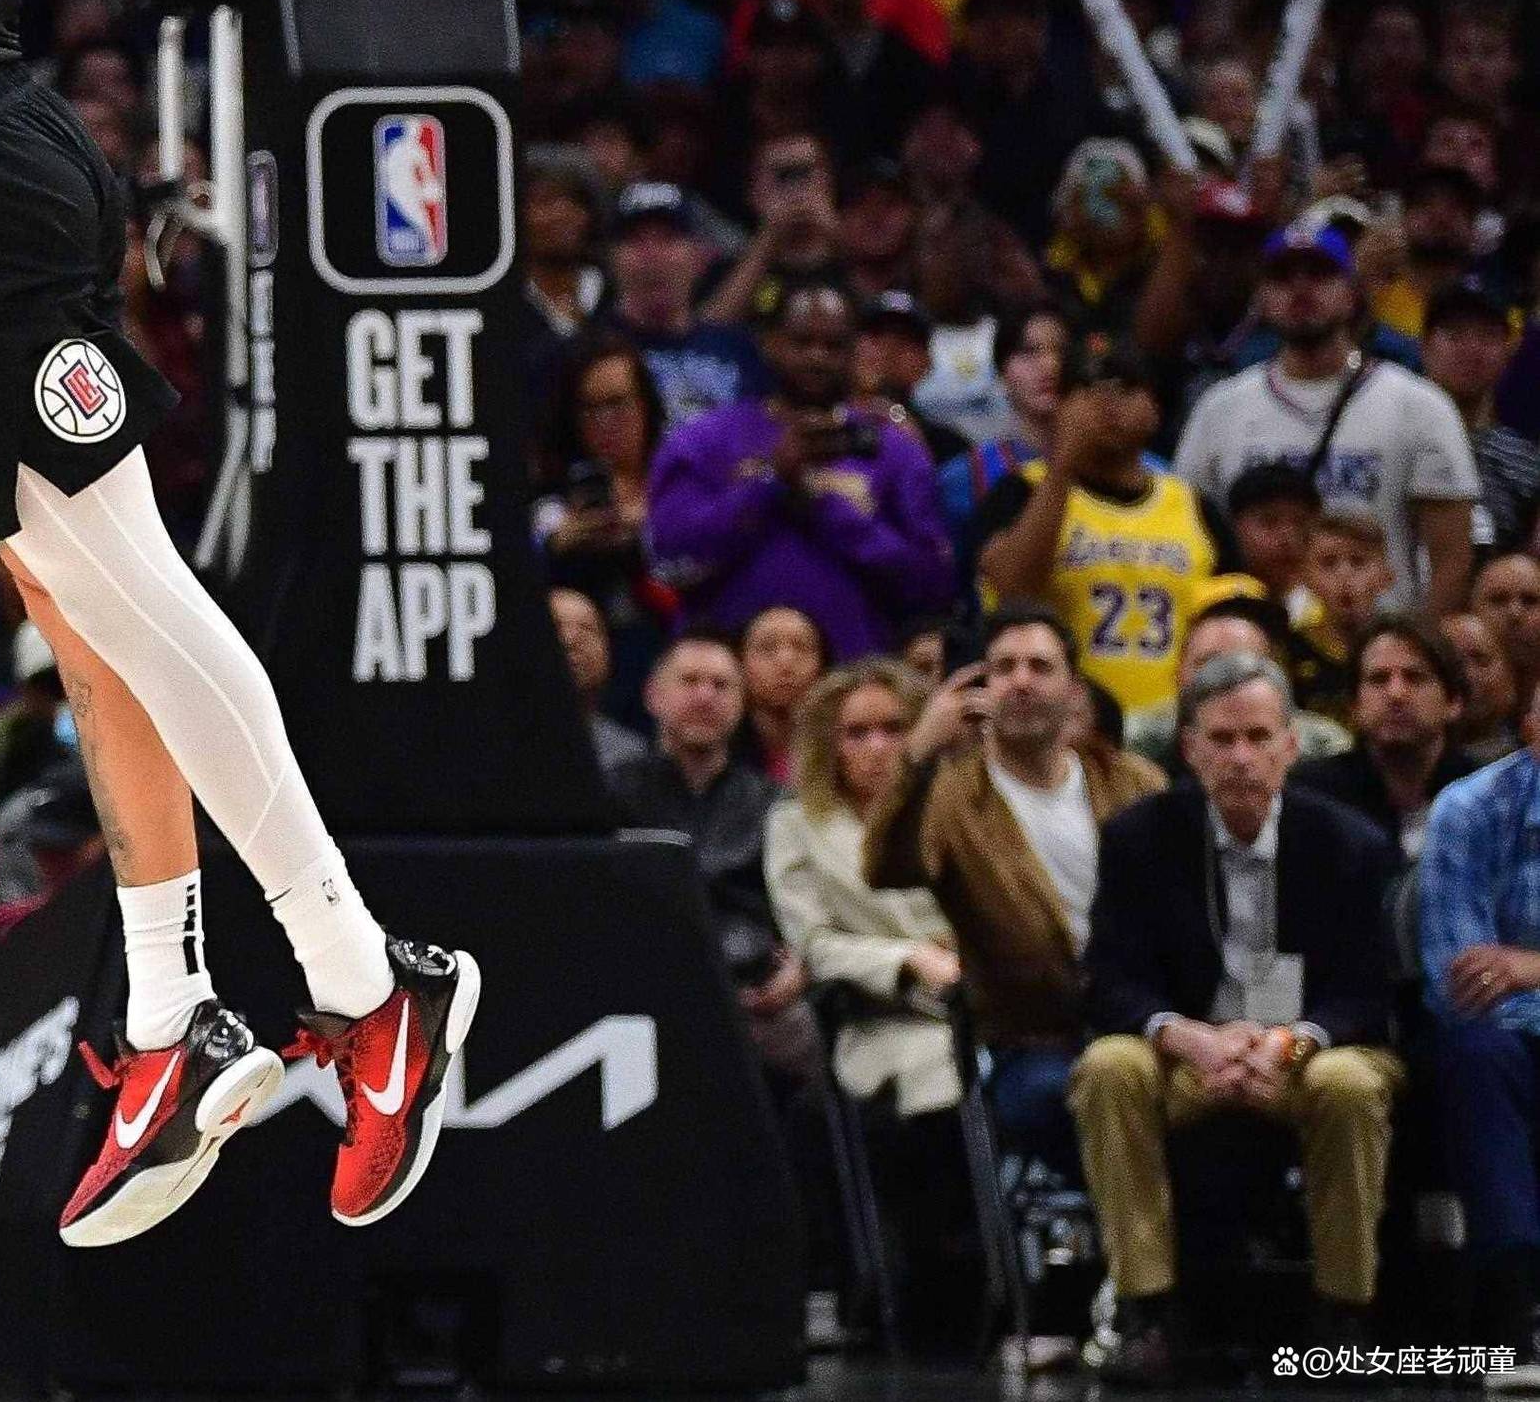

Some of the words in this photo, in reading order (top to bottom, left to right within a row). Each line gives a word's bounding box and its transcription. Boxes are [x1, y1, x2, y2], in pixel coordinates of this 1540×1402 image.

[345, 309, 484, 433] GET
[346, 435, 493, 556] THE
[351, 562, 497, 684] APP
[1089, 581, 1174, 657] 23
